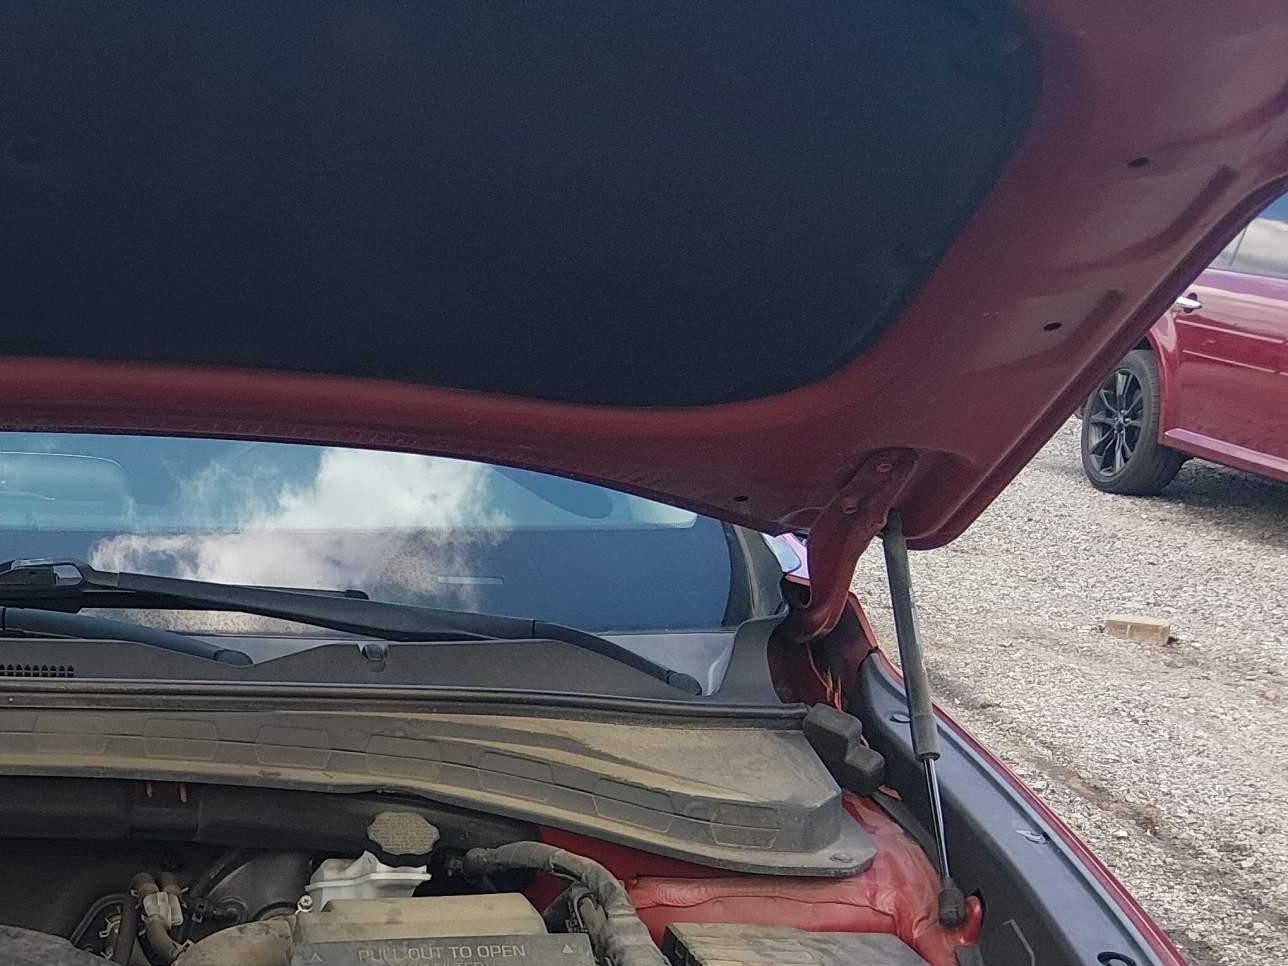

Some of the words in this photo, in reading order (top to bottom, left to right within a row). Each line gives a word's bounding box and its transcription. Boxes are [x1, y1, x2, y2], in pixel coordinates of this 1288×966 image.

[358, 947, 405, 962] PULL
[407, 946, 443, 960] OUT
[448, 946, 472, 959] TO
[476, 944, 527, 958] OPEN
